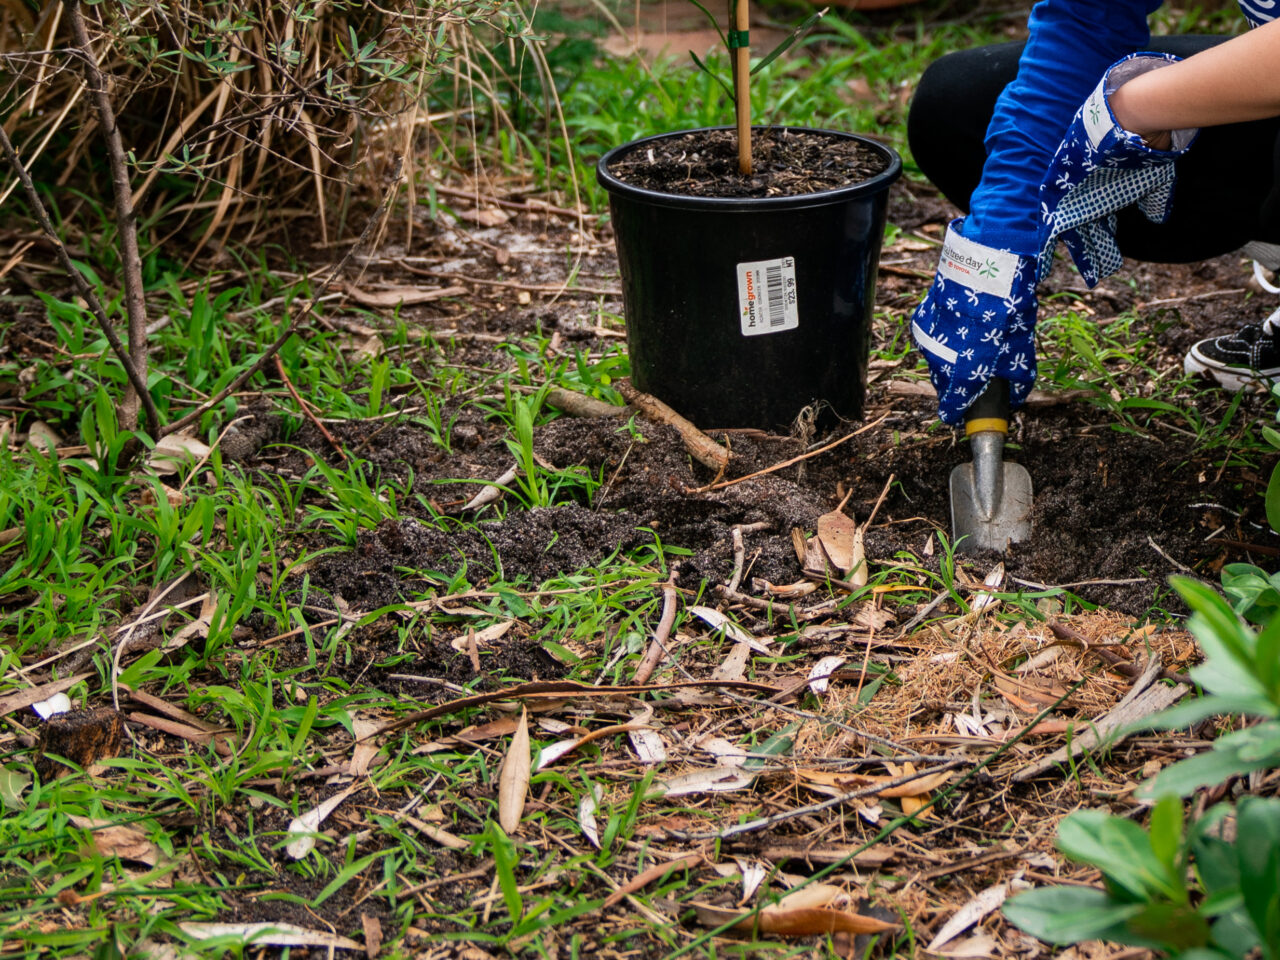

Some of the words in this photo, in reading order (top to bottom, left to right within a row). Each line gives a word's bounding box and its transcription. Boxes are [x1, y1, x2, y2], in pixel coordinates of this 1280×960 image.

[950, 249, 965, 262] tree
[966, 256, 983, 271] day
[953, 263, 971, 275] TOYOTA
[746, 271, 756, 328] homegrown
